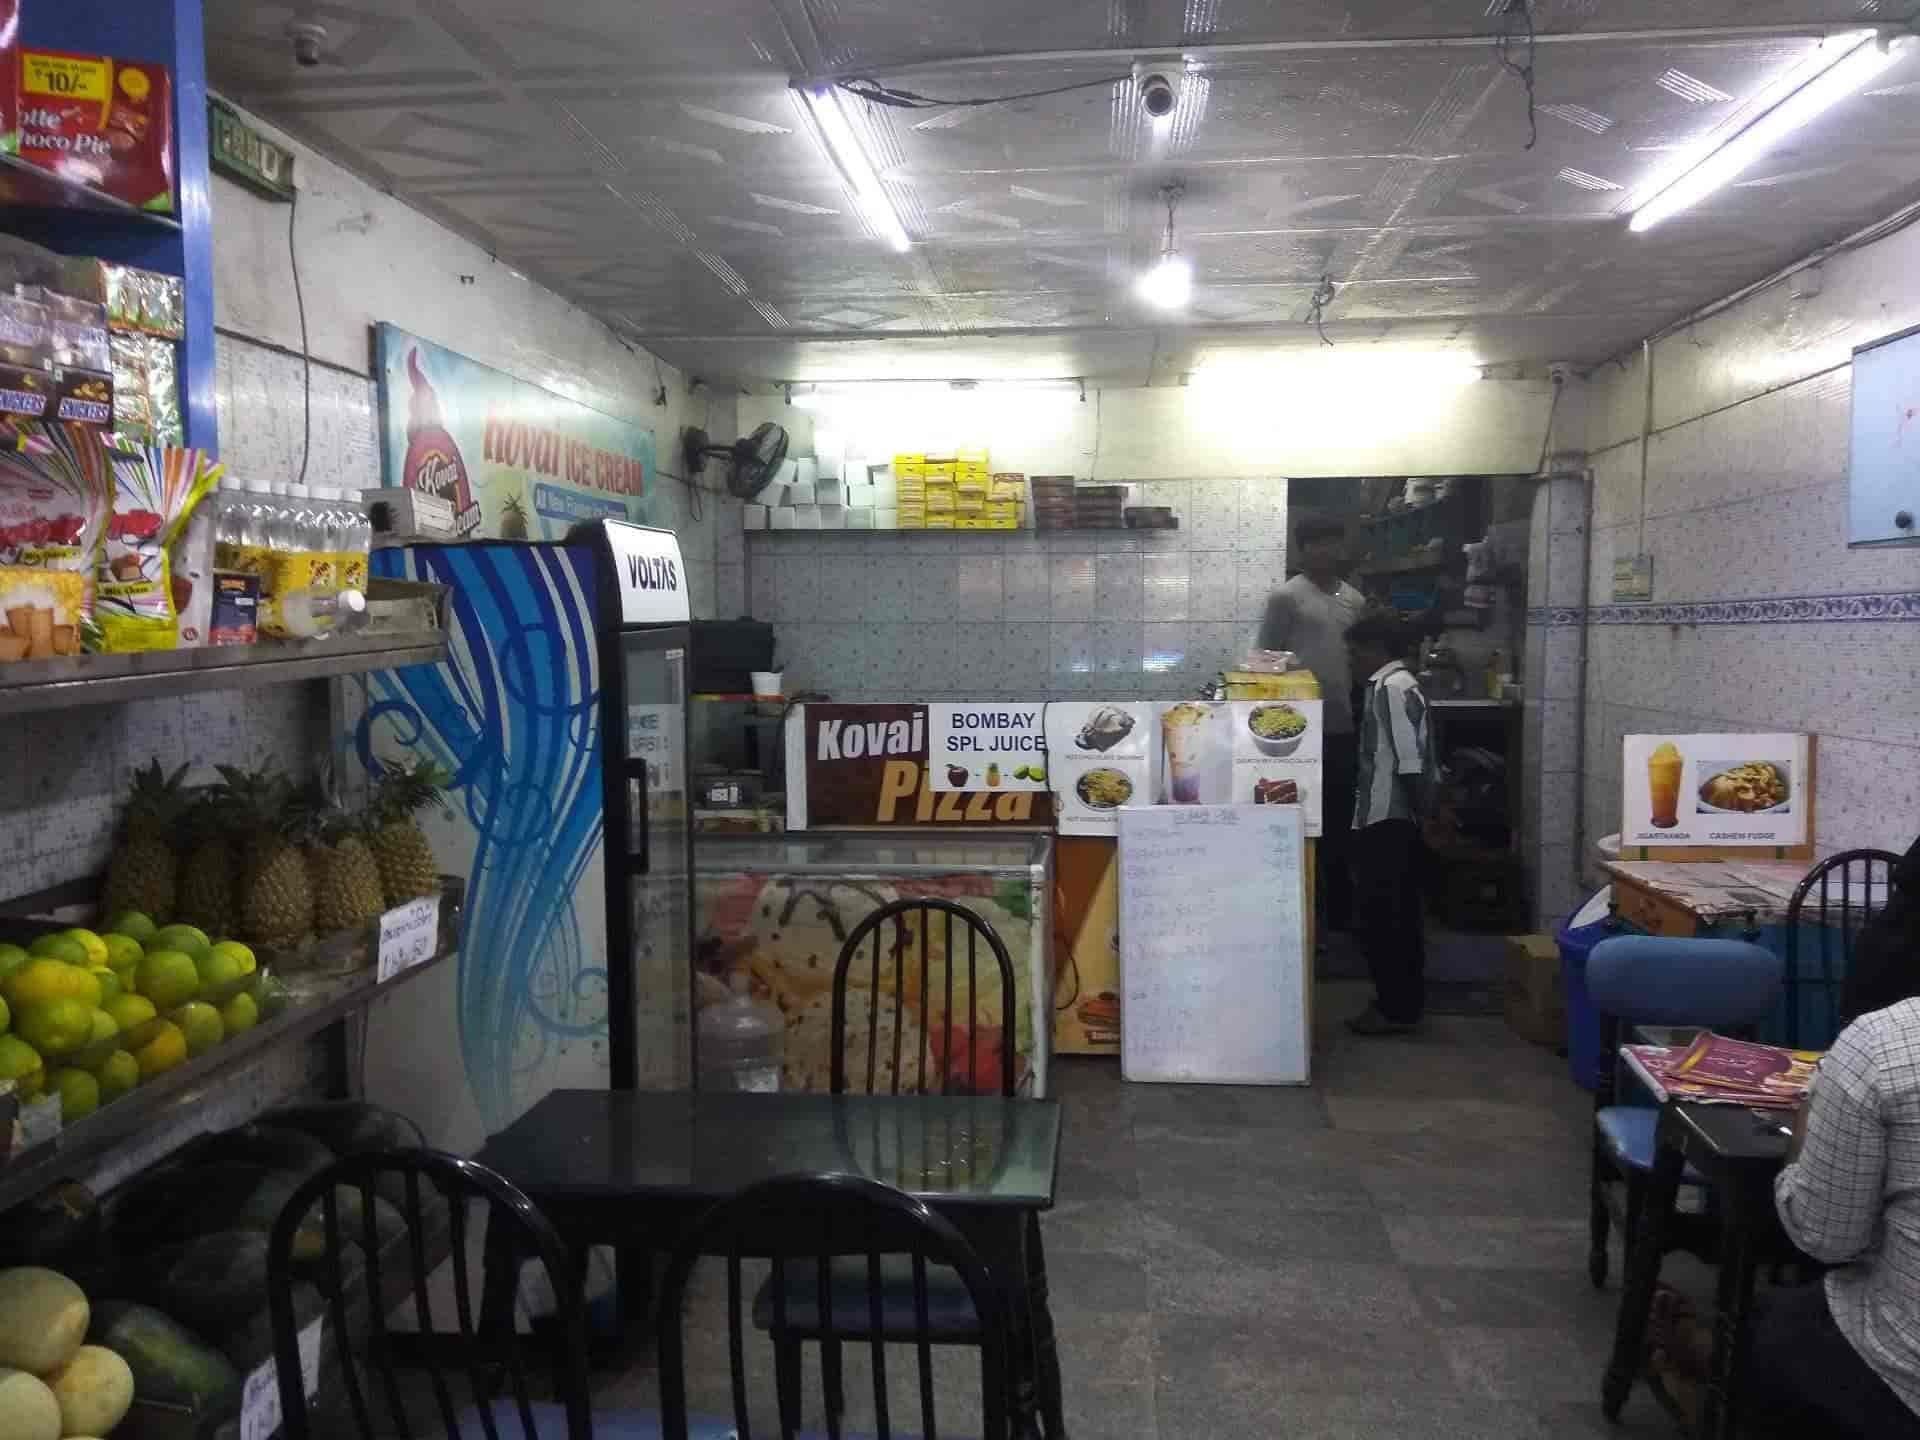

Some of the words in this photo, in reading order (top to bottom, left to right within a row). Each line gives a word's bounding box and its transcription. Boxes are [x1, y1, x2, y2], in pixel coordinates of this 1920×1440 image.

[566, 435, 592, 486] ICE
[594, 450, 644, 497] CREAM
[628, 554, 677, 593] VOLTAS
[817, 711, 924, 761] Kovai
[951, 712, 1036, 729] BOMBAY
[946, 735, 984, 752] SPL
[989, 735, 1046, 752] JUICE
